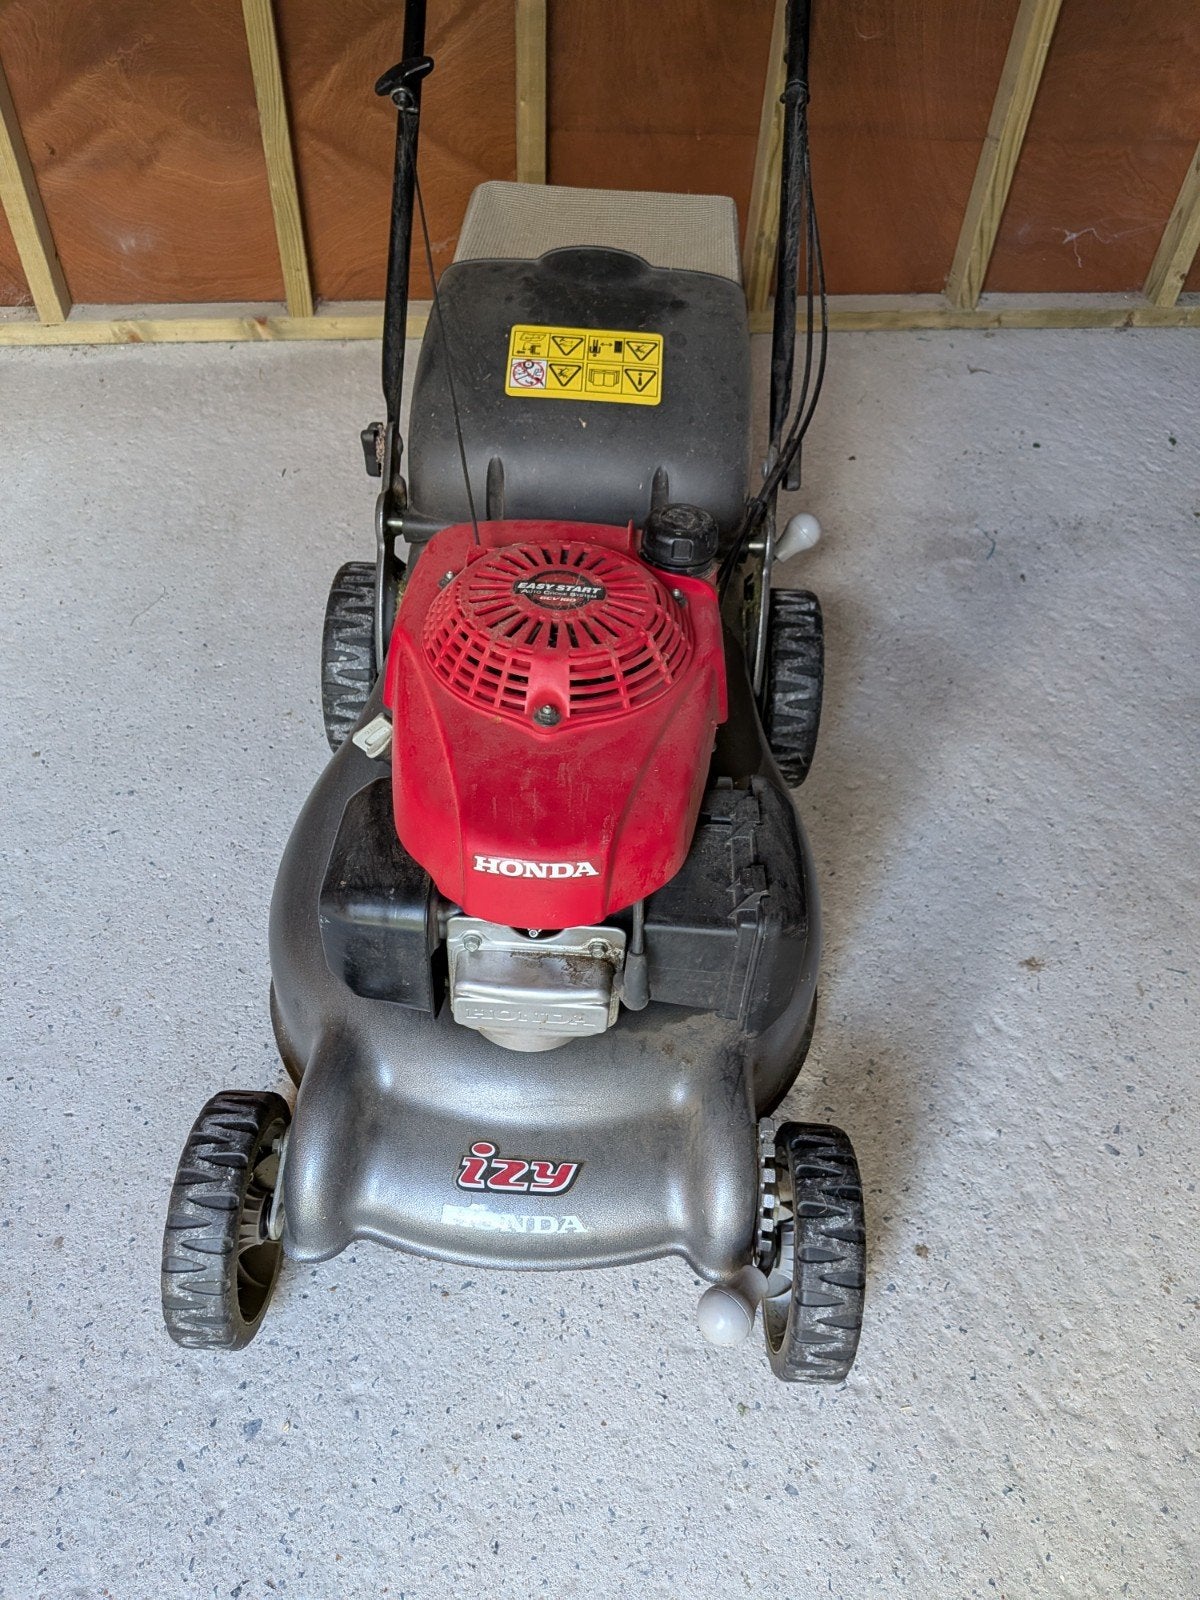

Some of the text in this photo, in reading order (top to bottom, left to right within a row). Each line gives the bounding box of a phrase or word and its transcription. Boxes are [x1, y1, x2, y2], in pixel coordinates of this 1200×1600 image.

[517, 582, 602, 594] EASY START
[473, 855, 600, 879] HONDA
[465, 1008, 596, 1026] HONDA
[457, 1141, 582, 1195] izy
[441, 1203, 588, 1234] NDA
